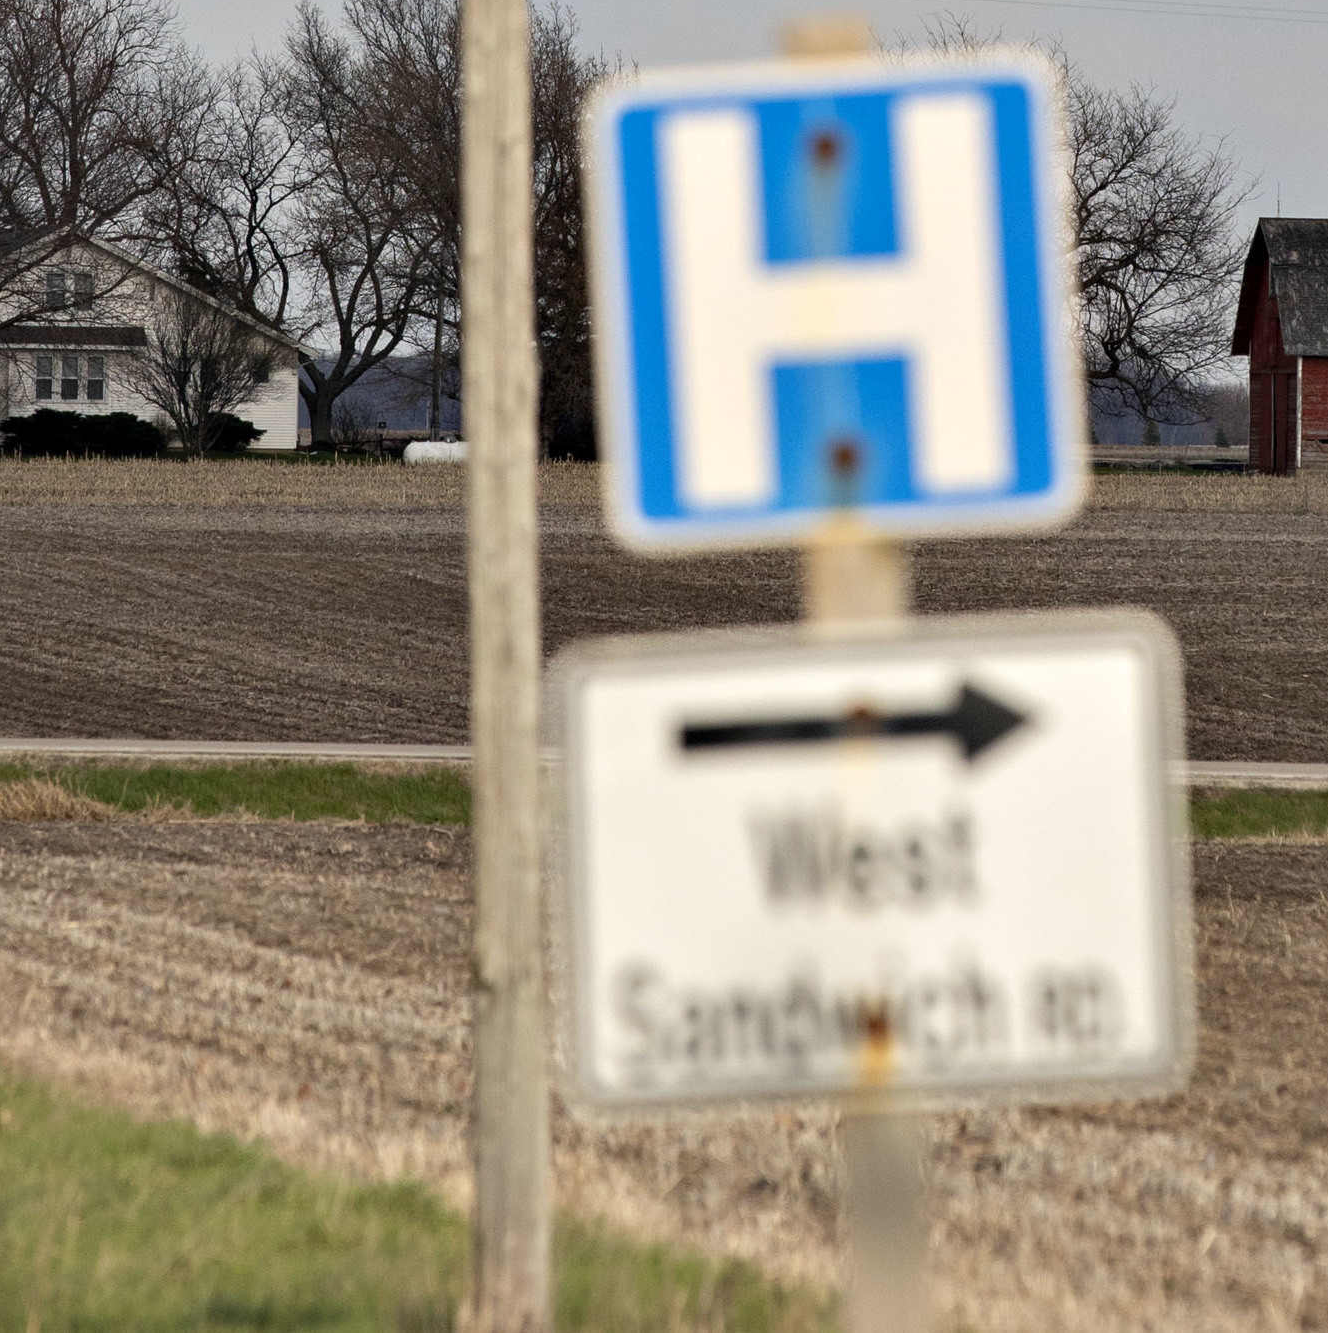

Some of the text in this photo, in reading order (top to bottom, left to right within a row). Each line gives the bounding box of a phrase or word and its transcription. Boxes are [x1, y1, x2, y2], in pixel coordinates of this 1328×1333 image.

[657, 92, 1013, 512] H
[743, 802, 985, 916] West
[613, 950, 1007, 1078] Sandwich
